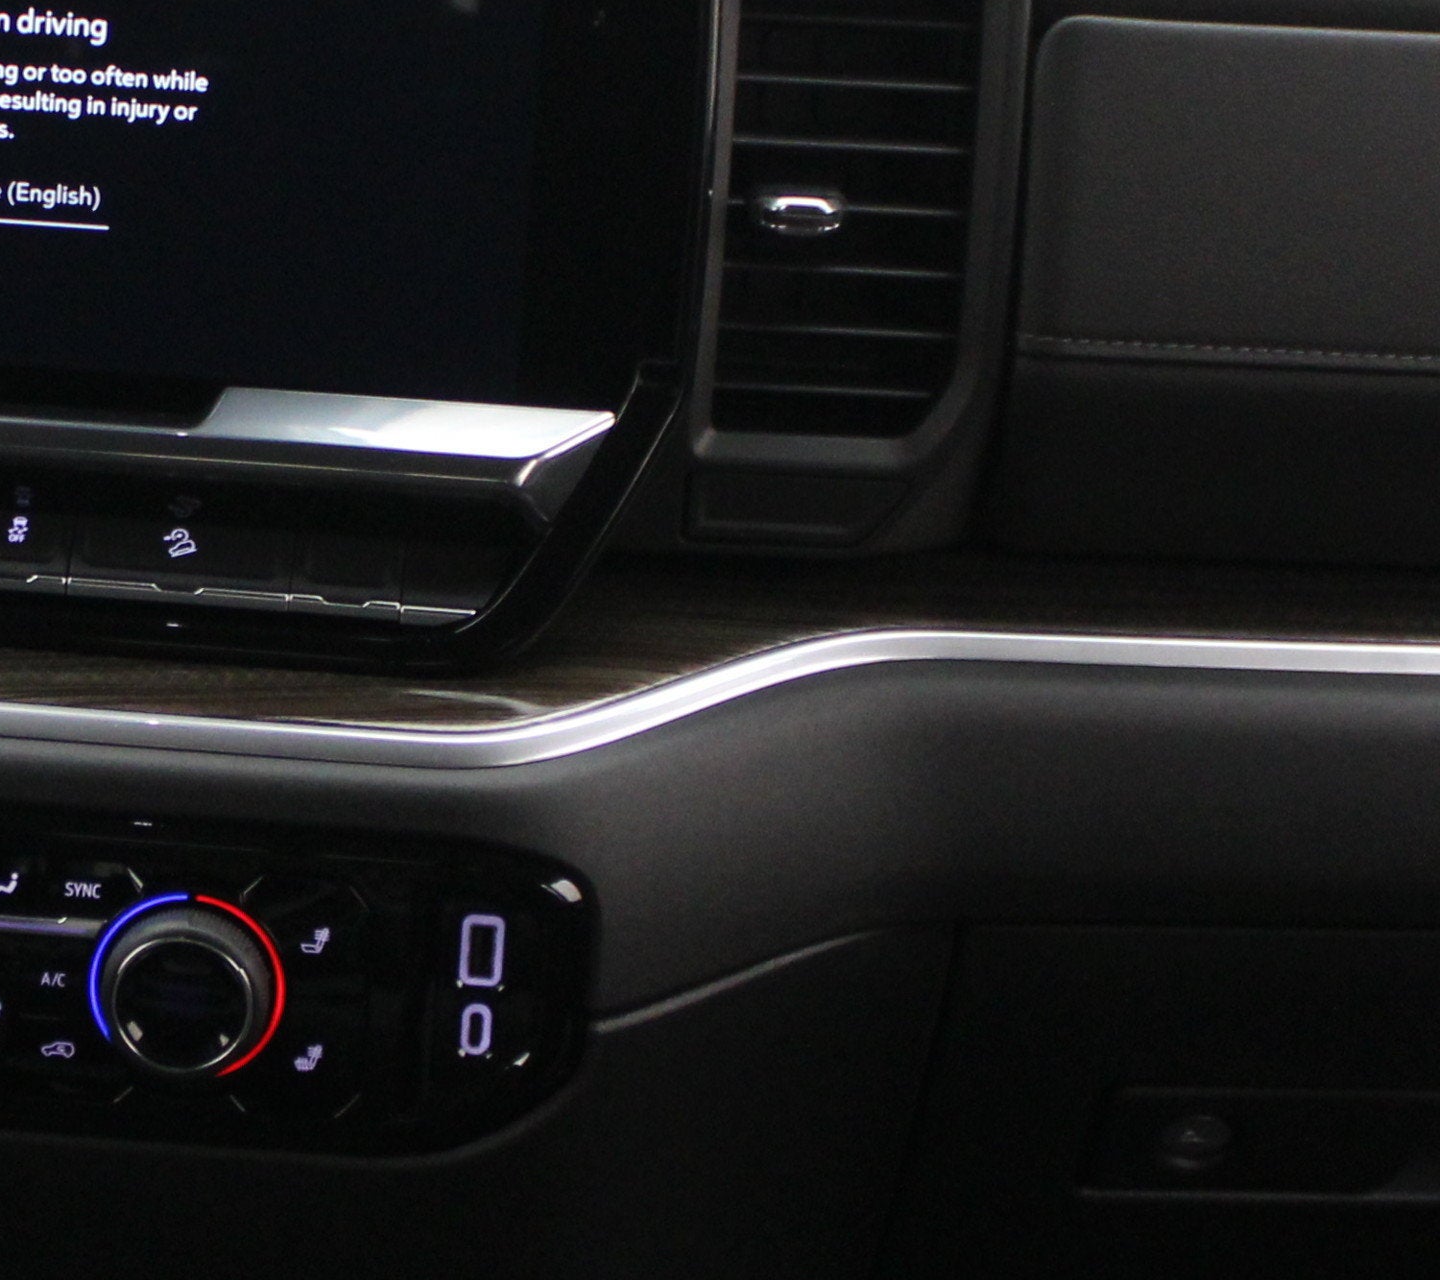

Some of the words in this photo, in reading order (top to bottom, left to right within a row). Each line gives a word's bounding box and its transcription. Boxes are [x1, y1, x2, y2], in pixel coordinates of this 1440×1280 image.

[17, 7, 107, 44] driving
[23, 66, 47, 81] or
[51, 64, 87, 84] too
[91, 65, 148, 88] often
[153, 69, 208, 92] while
[87, 95, 105, 115] in
[111, 97, 170, 124] injury
[174, 105, 198, 120] or
[7, 181, 101, 211] (English)
[64, 881, 102, 899] SYNC
[41, 972, 66, 987] A/C
